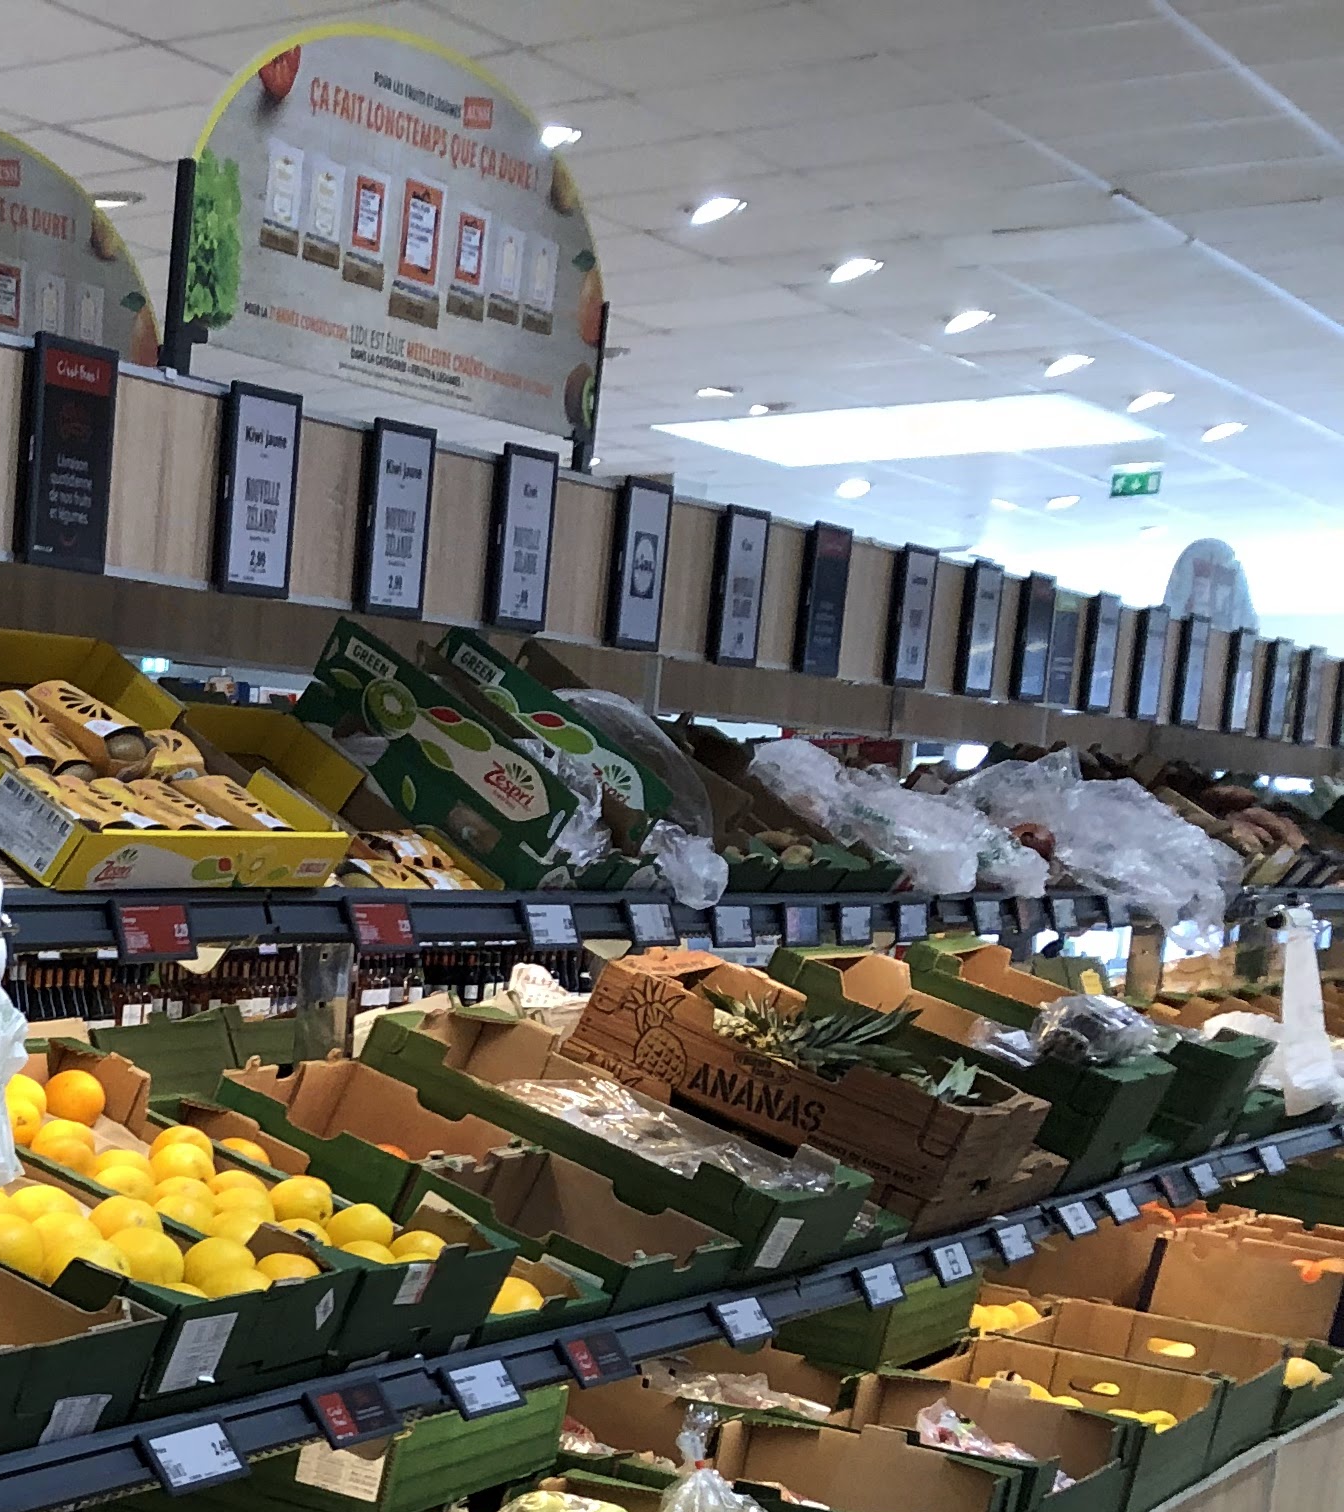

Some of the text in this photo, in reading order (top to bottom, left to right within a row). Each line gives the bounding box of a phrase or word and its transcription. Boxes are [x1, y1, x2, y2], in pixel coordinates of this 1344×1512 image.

[310, 77, 330, 117] ÇA
[332, 85, 364, 125] FAIT
[367, 98, 449, 160] LONGTEMPS
[450, 132, 478, 170] QUE
[480, 144, 497, 180] ÇA
[10, 202, 29, 233] ÇA
[245, 424, 263, 444] Kiwi
[351, 641, 392, 678] GREEN
[459, 650, 499, 685] GREEN
[483, 760, 536, 808] Zespri
[688, 1062, 827, 1133] ANANAS
